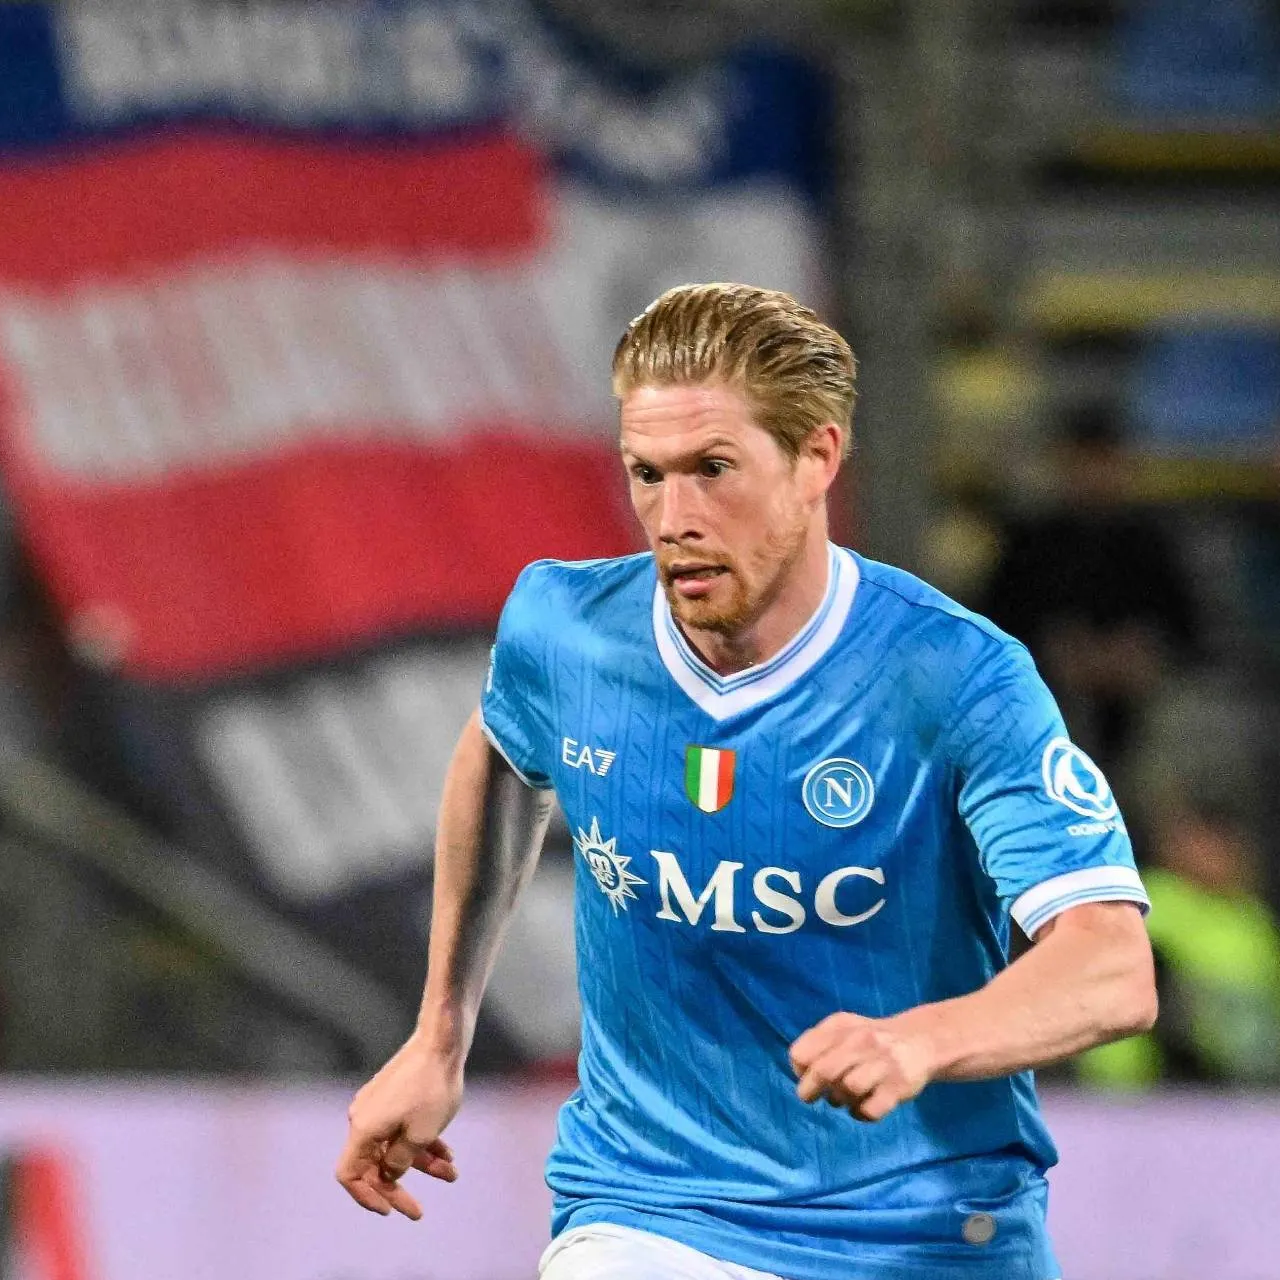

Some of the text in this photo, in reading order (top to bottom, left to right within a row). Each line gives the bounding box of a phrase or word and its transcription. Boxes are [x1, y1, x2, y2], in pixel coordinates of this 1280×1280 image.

[562, 737, 617, 777] EA7
[823, 777, 855, 808] N
[649, 849, 887, 935] MSC
